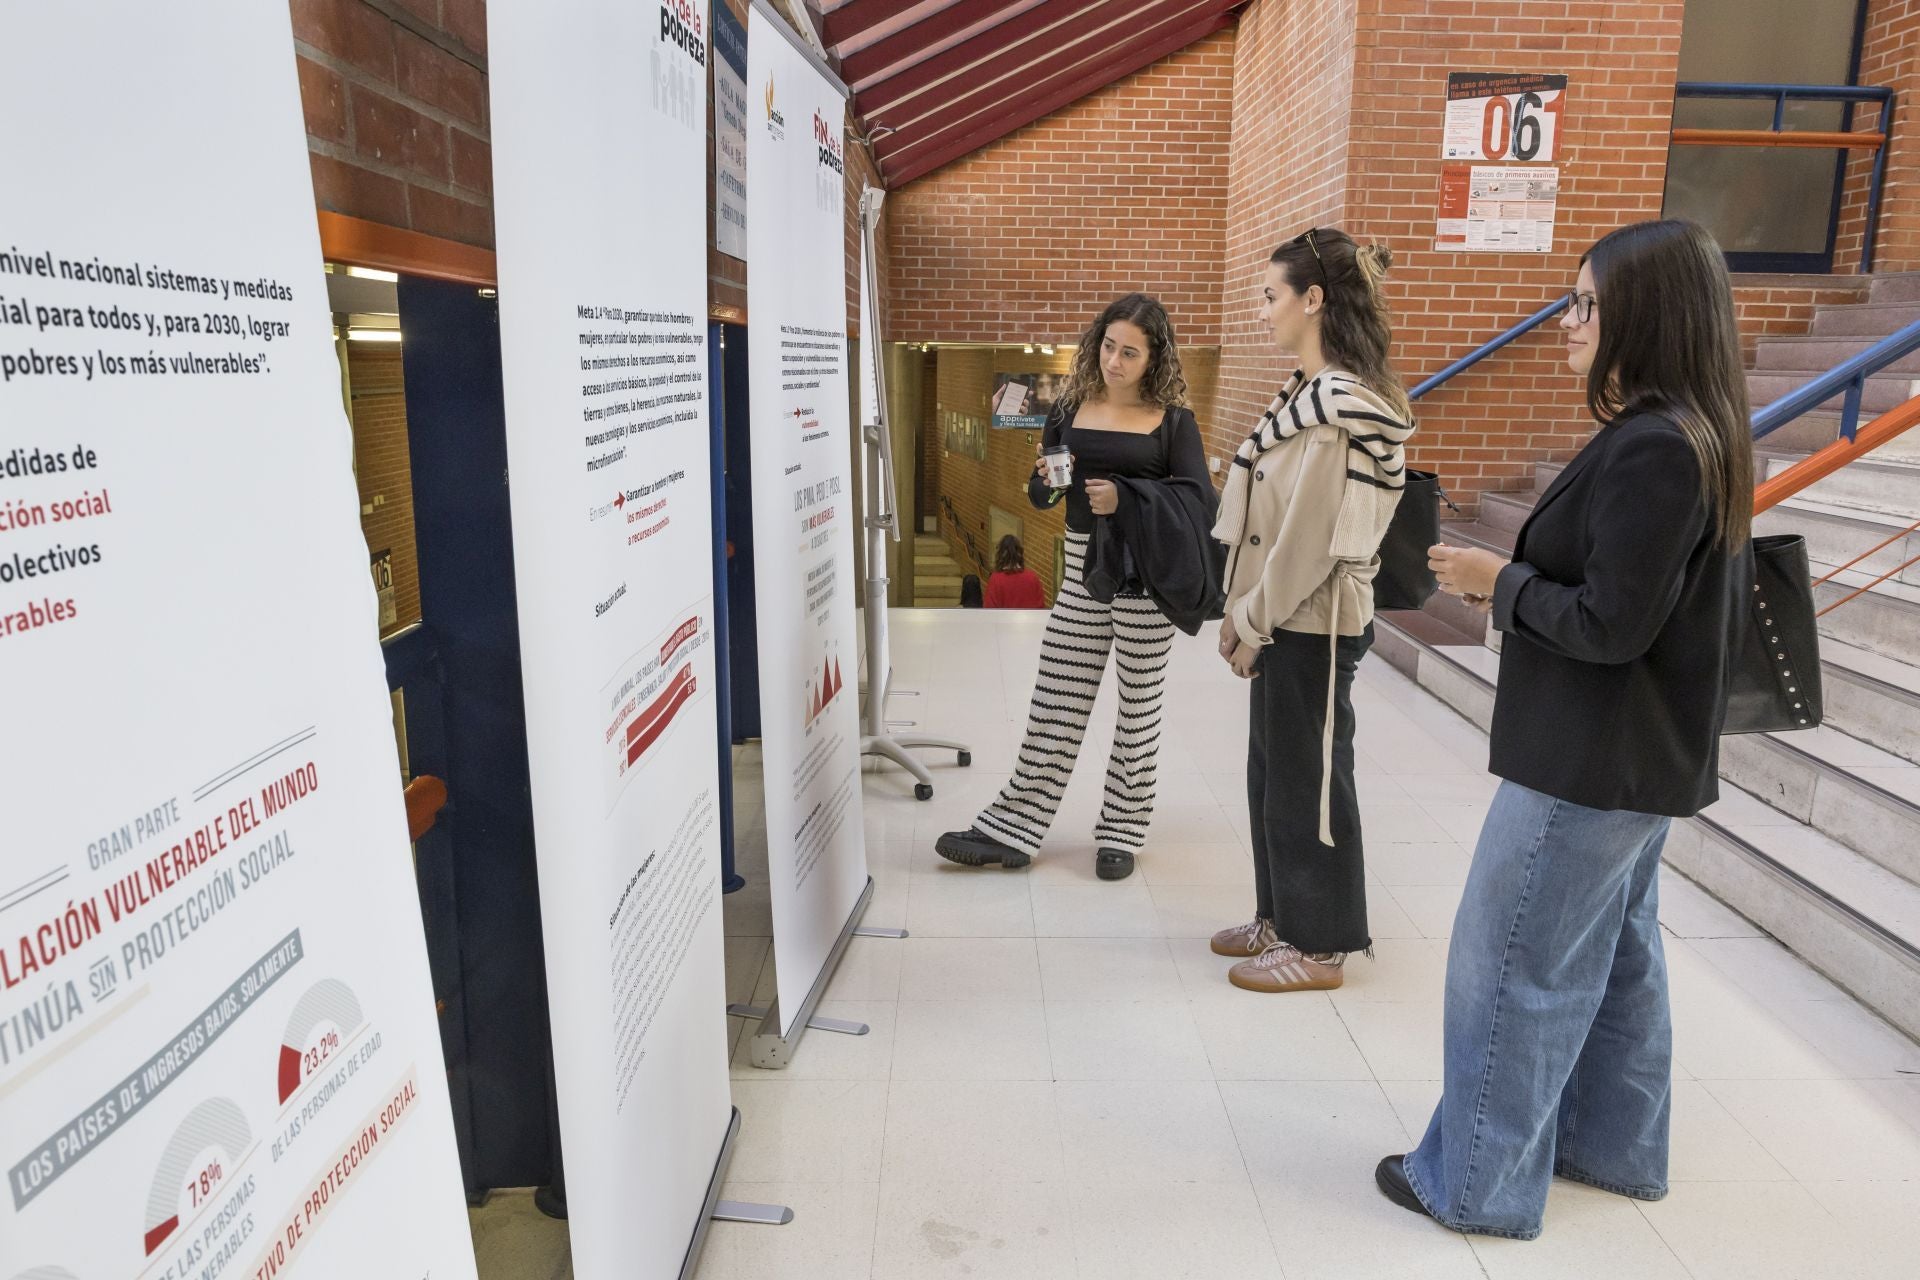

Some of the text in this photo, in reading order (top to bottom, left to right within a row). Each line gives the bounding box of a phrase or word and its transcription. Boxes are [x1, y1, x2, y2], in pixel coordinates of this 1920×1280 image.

[661, 5, 705, 67] pobreza
[1478, 79, 1487, 88] de
[1488, 77, 1517, 89] urgencia
[1519, 74, 1544, 84] médica
[1493, 85, 1521, 95] teléfono
[814, 111, 829, 147] FIN
[1481, 89, 1567, 161] 061
[818, 145, 843, 175] pobreza
[1504, 171, 1531, 179] primeros
[1532, 171, 1556, 179] auxilios
[0, 246, 293, 302] nivel nacional sistemas y medidas
[0, 295, 290, 342] ial para todos y, para 2030, lograr
[577, 304, 594, 319] Meta
[595, 306, 603, 320] 1.4
[625, 309, 648, 325] garantizar
[670, 312, 691, 324] hombres
[579, 329, 604, 348] mujeres,
[629, 331, 637, 344] los
[1, 347, 79, 382] pobres
[81, 354, 94, 381] y
[98, 349, 127, 375] los
[129, 349, 167, 376] más
[580, 355, 591, 371] los
[630, 353, 638, 367] los
[677, 351, 685, 363] así
[582, 383, 602, 396] acceso
[628, 375, 648, 391] básicos,
[584, 406, 603, 422] tierras
[631, 399, 636, 412] la
[1000, 415, 1036, 424] apptivate
[585, 432, 605, 447] nuevas
[629, 422, 637, 435] los
[71, 443, 98, 470] de
[50, 488, 112, 523] social
[626, 484, 651, 502] Garantizar
[794, 489, 803, 512] LOS
[626, 512, 635, 525] los
[632, 527, 652, 544] recursos
[0, 597, 77, 638] rables
[87, 796, 182, 872] GRAN PARTE
[104, 816, 228, 924] VULNERABLE
[228, 796, 261, 841] DEL
[261, 761, 319, 819] MUNDO
[88, 960, 118, 999] SIN
[121, 867, 237, 980] PROTECCIÓN
[238, 829, 295, 891] SOCIAL
[17, 939, 298, 1198] LOS PAÍSES DE INGRESOS BAJOS, SOLAMENTE
[304, 1029, 339, 1076] 23.2%
[271, 1031, 382, 1164] DE LAS PERSONAS DE EDAD
[286, 1213, 304, 1251] DE
[305, 1122, 379, 1225] PROTECCIÓN
[380, 1079, 417, 1134] SOCIAL
[188, 1157, 223, 1209] 7.8%
[177, 1173, 256, 1279] LAS PERSONAS
[198, 1212, 256, 1280] NERABLES
